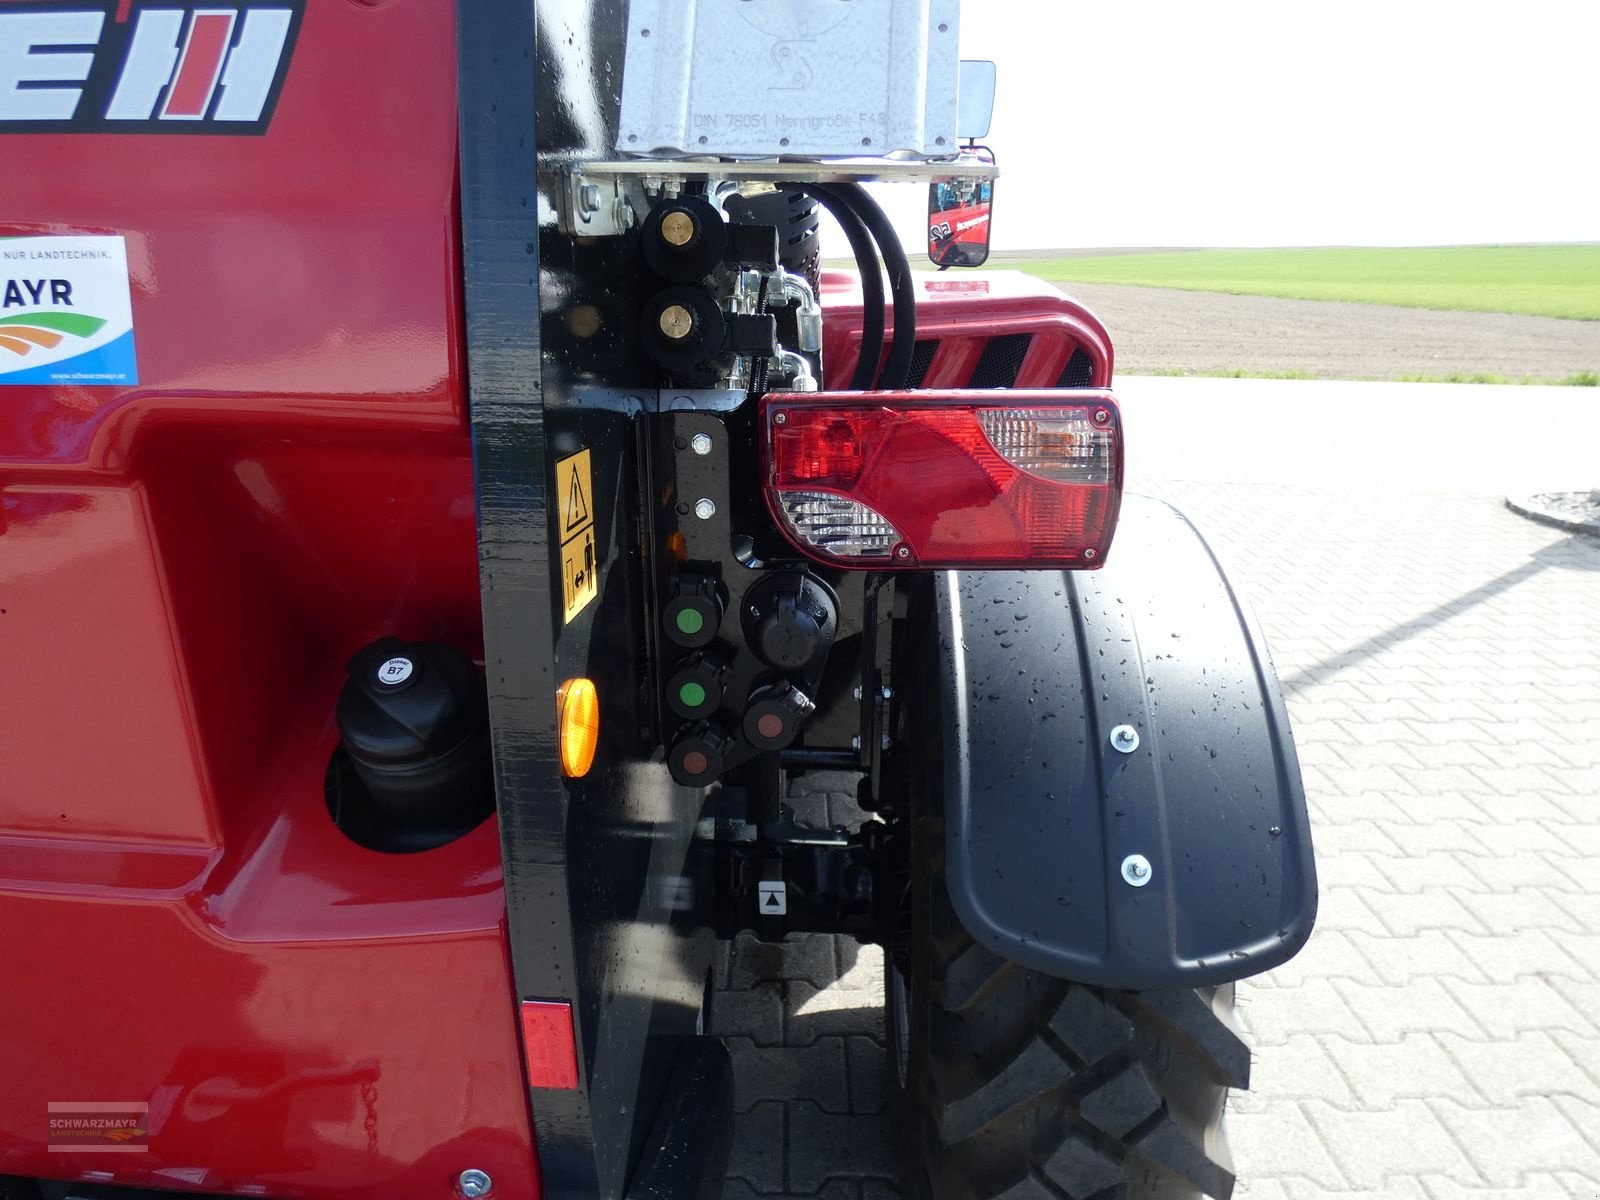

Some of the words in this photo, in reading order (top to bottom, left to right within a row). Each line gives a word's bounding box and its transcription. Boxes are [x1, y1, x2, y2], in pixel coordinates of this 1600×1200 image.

[693, 114, 718, 129] DIN
[726, 114, 768, 128] 76051
[775, 114, 852, 130] Nenngröße
[4, 251, 26, 260] NUR
[30, 250, 112, 260] LANDTECHNIK.
[3, 279, 74, 308] AYR
[387, 666, 404, 675] B7
